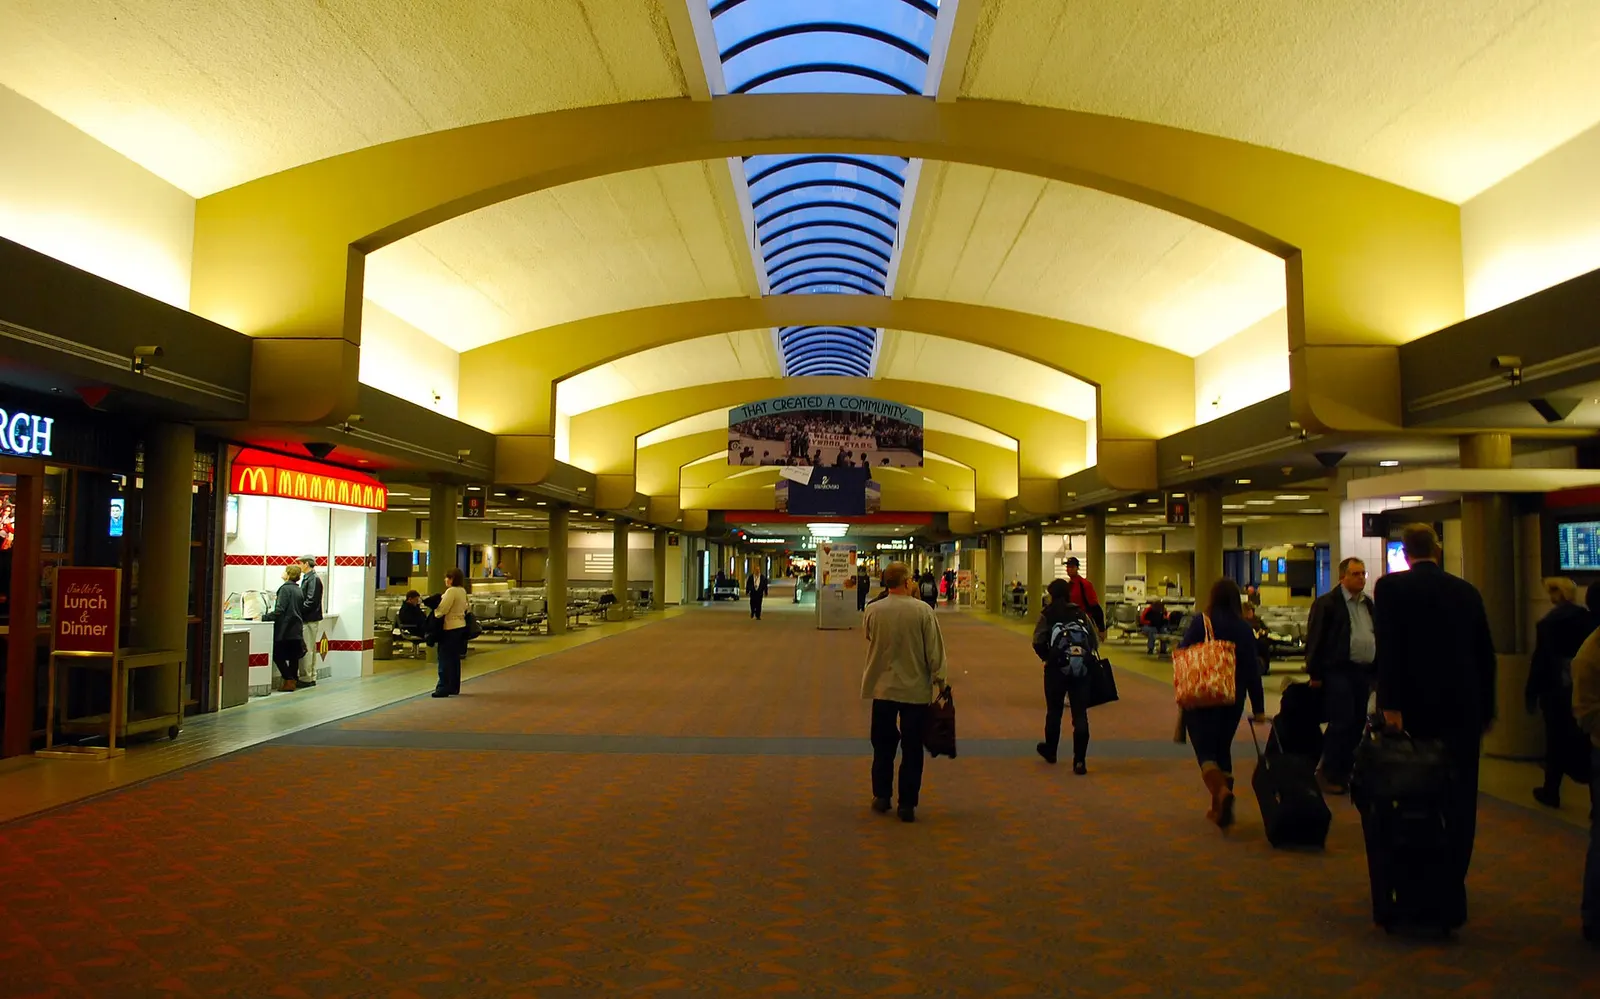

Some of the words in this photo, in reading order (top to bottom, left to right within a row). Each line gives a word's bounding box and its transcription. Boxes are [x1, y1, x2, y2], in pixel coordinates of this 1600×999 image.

[741, 402, 767, 418] THAT
[772, 397, 822, 411] CREATED
[827, 397, 835, 408] A
[840, 397, 911, 421] COMMUNITY...
[67, 583, 80, 594] Join
[81, 584, 90, 594] Us
[64, 594, 107, 609] Lunch
[80, 610, 90, 623] &
[61, 620, 108, 636] Dinner
